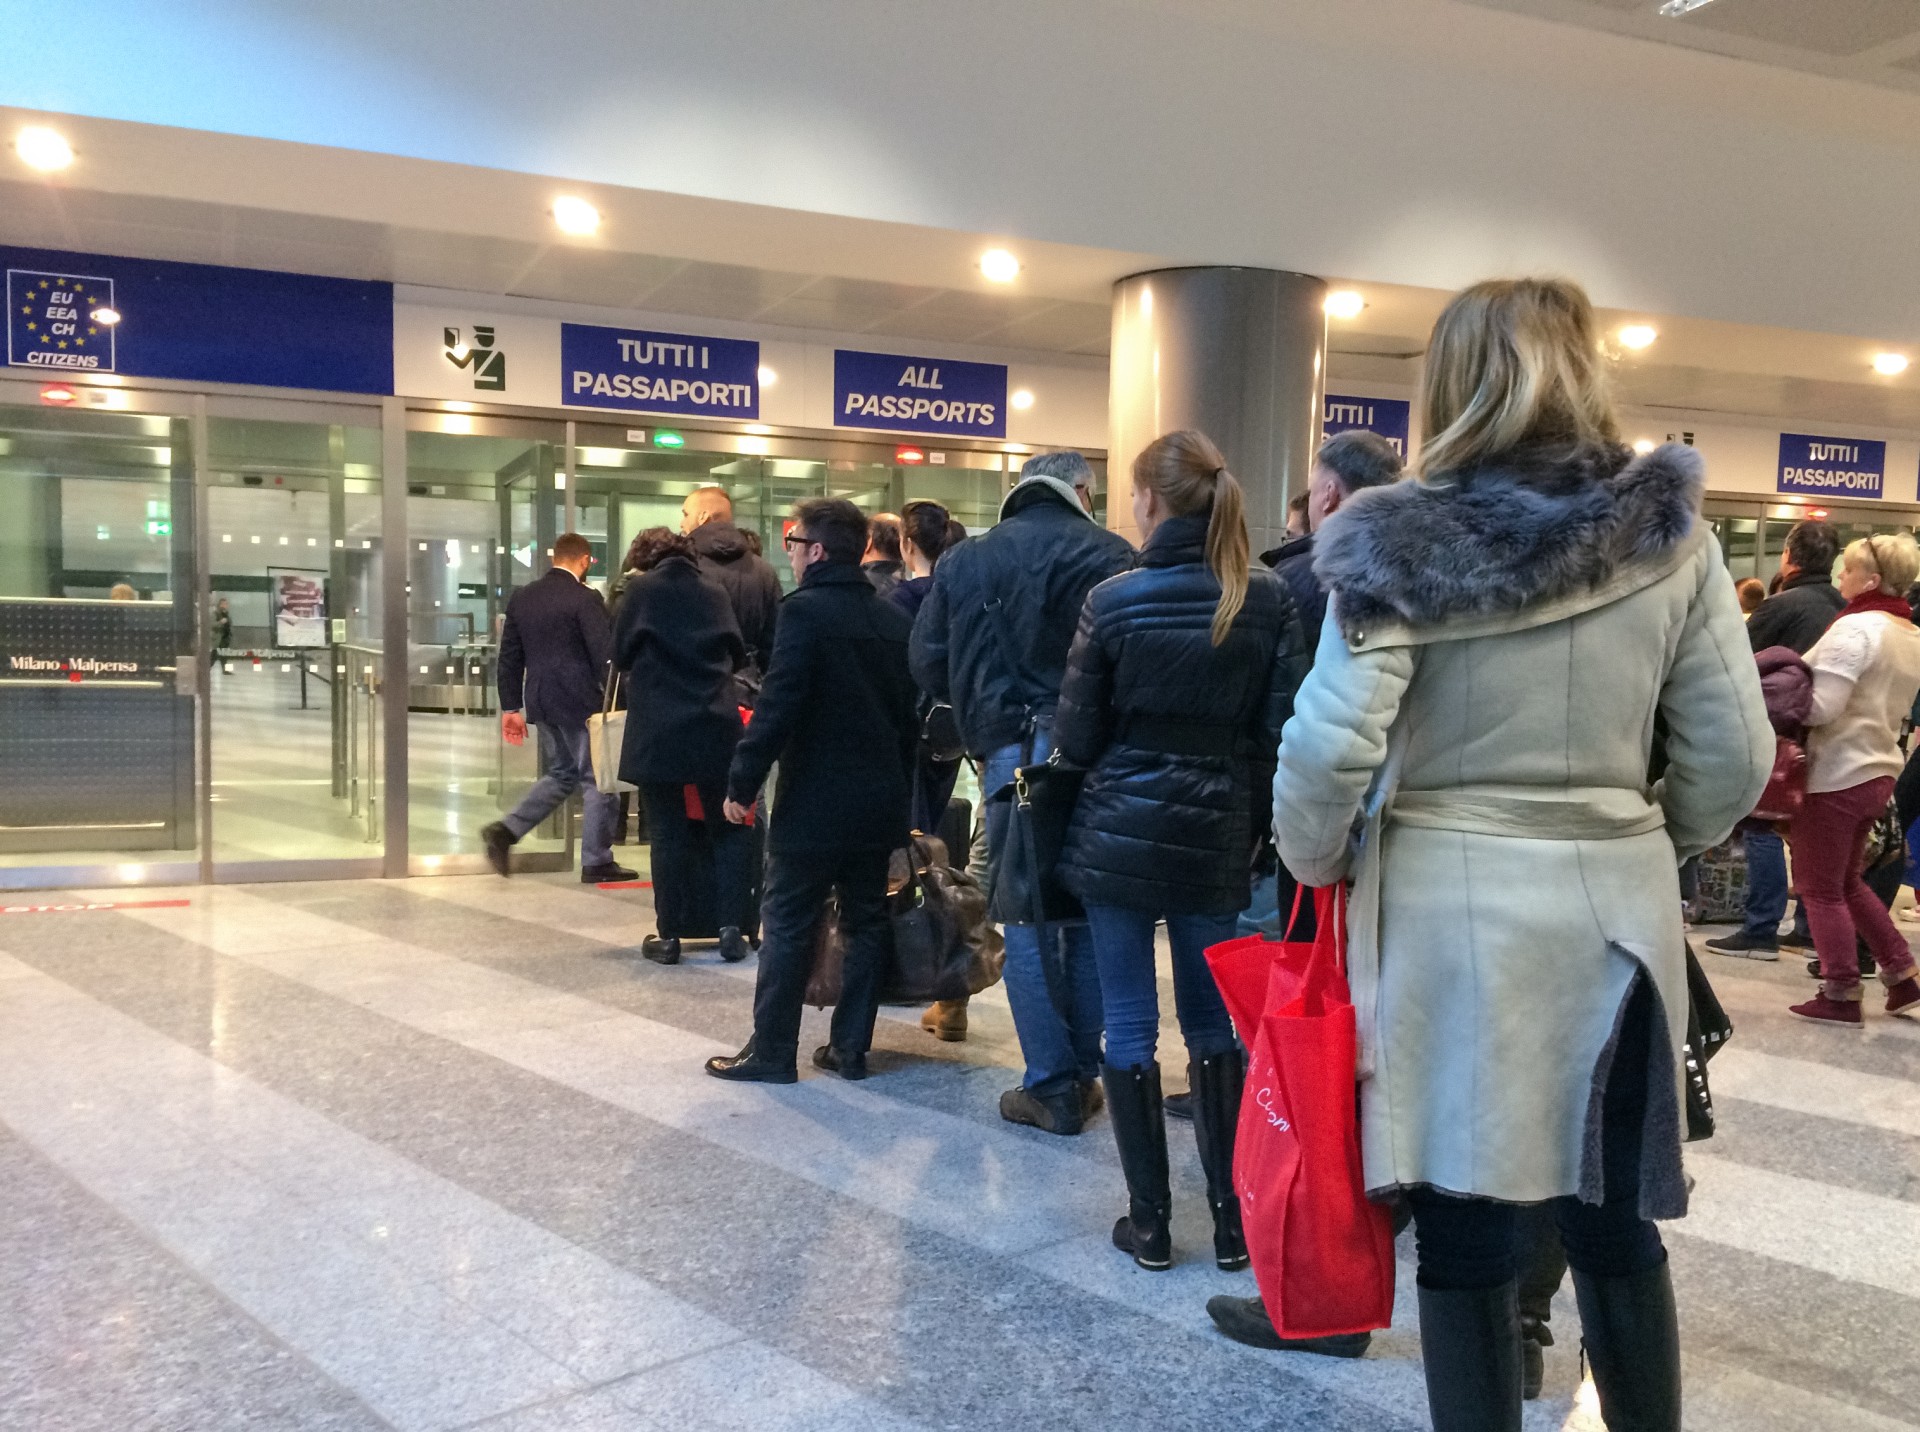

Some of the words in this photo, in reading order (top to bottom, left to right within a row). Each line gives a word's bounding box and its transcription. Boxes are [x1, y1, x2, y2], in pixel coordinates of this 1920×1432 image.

[51, 291, 74, 304] EU
[46, 307, 78, 320] EEA
[51, 322, 76, 336] CH
[26, 351, 99, 368] CITIZENS
[617, 339, 694, 368] TUTTI
[701, 347, 709, 369] I
[897, 366, 944, 390] ALL
[573, 371, 751, 407] PASSAPORTI
[844, 393, 996, 426] PASSPORTS
[1324, 403, 1363, 425] UTTI
[1808, 443, 1850, 463] TUTTI
[1853, 446, 1859, 463] I
[1783, 467, 1879, 490] PASSAPORTI
[10, 656, 60, 670] Milano
[69, 658, 138, 674] Malpensa
